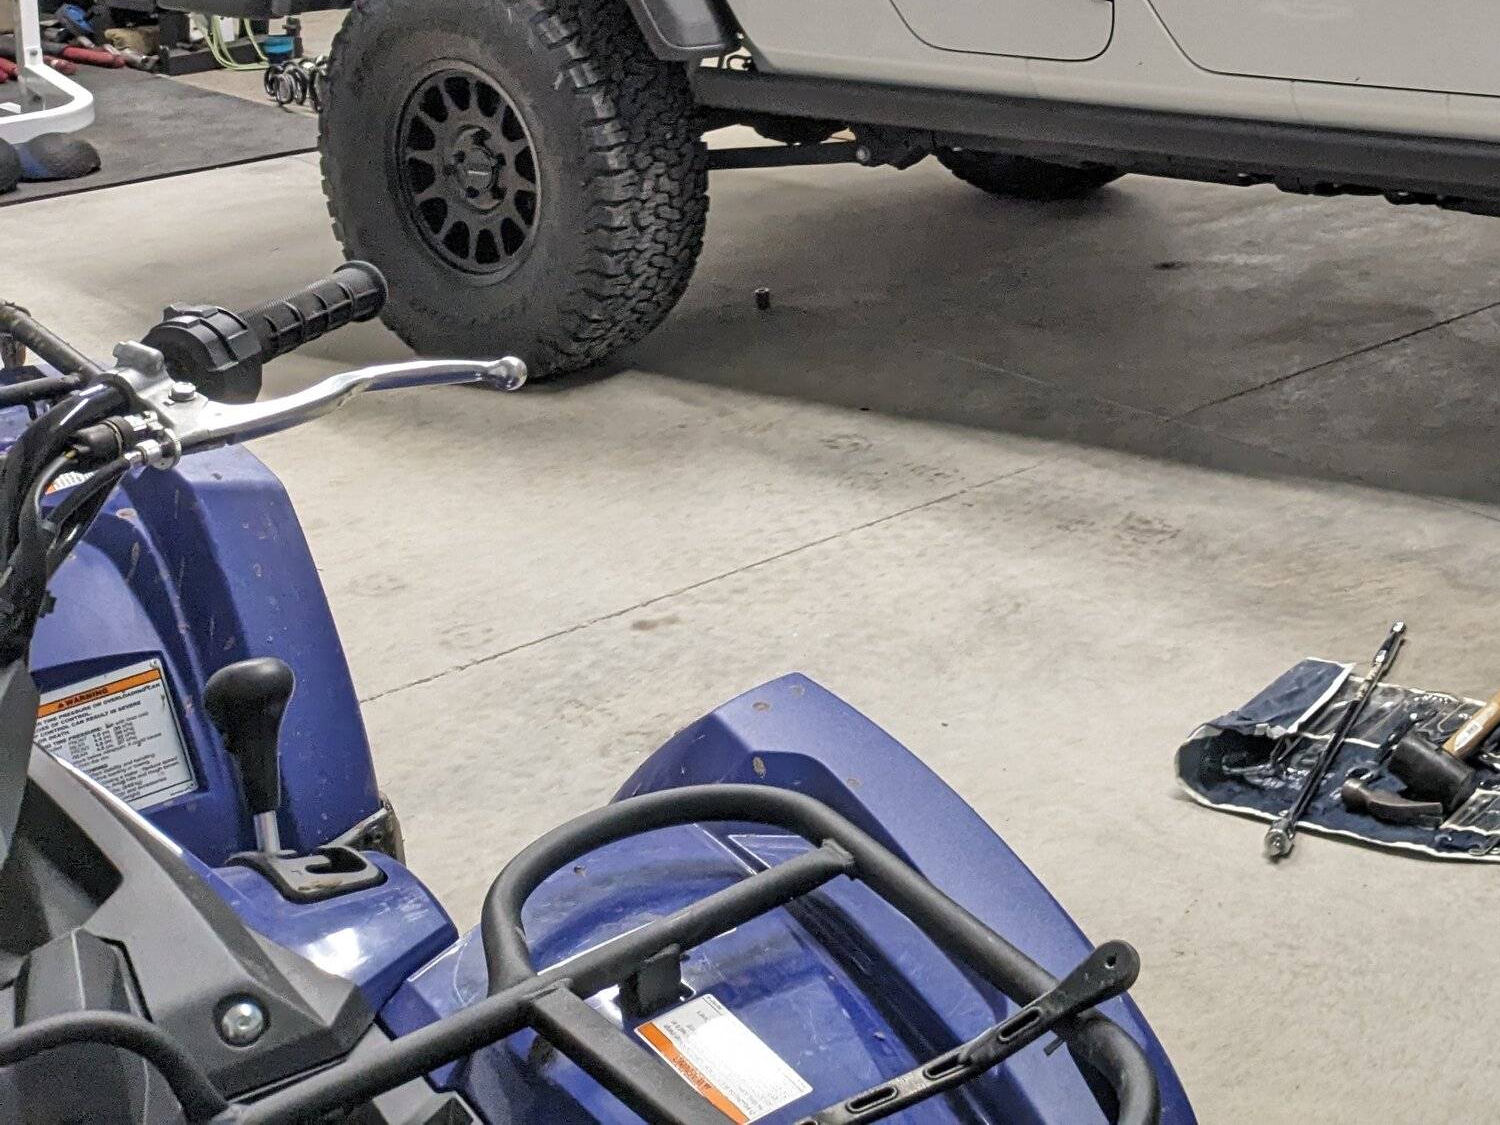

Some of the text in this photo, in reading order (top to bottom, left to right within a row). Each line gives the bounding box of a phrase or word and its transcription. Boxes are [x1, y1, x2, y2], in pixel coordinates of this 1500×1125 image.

[64, 687, 108, 705] WARNING
[58, 705, 90, 718] PRESSURE
[117, 700, 140, 711] SEVERE
